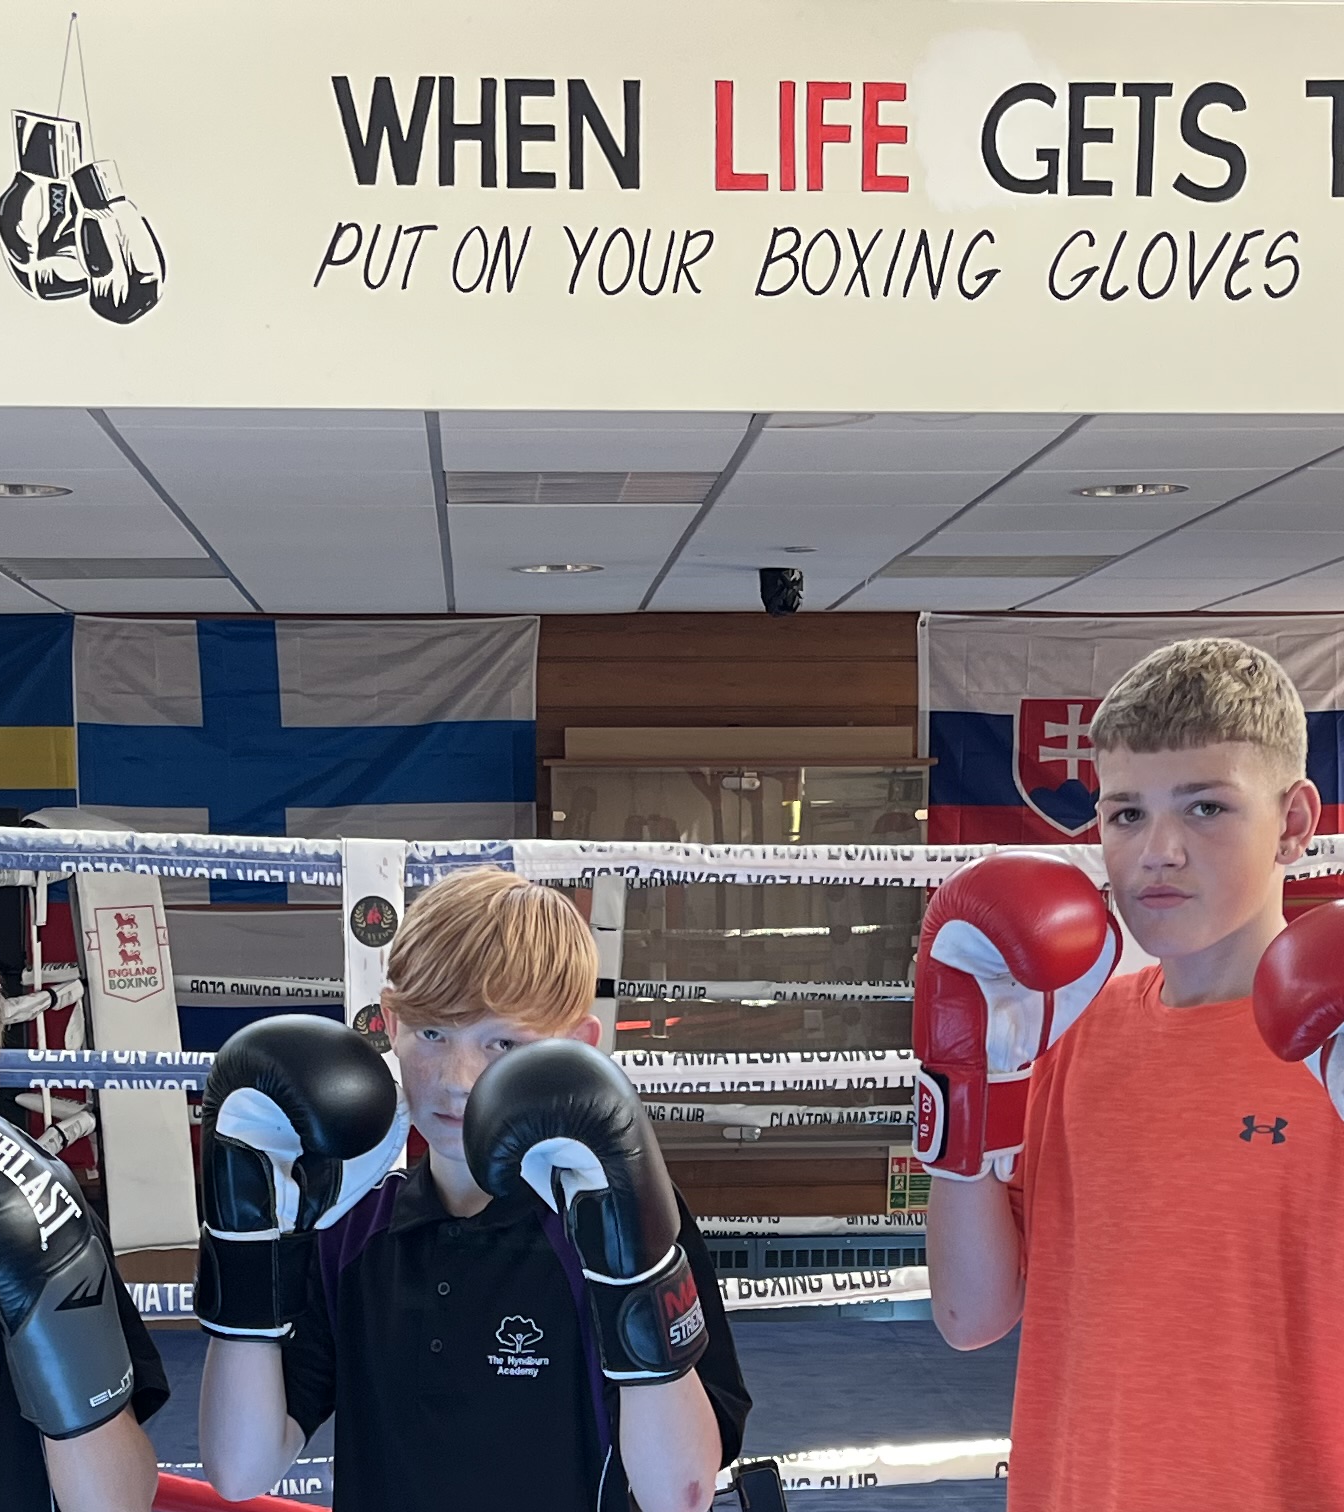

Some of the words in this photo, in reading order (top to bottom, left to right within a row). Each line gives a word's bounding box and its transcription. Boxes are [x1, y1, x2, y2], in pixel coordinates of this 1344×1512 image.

[332, 75, 642, 190] WHEN
[714, 80, 910, 192] LIFE
[979, 82, 1248, 202] GETS
[313, 222, 436, 290] PUT
[451, 225, 528, 292] ON
[564, 228, 713, 296] YOUR
[756, 228, 999, 300] BOXING
[1048, 230, 1303, 300] GLOVES
[108, 966, 157, 977] ENGLAND
[108, 976, 158, 990] BOXING
[617, 981, 668, 998] BOXING
[670, 1107, 704, 1123] CLUB
[737, 1274, 822, 1300] BOXING
[832, 1269, 891, 1290] CLUB
[487, 1356, 504, 1367] The
[497, 1365, 539, 1378] Academy
